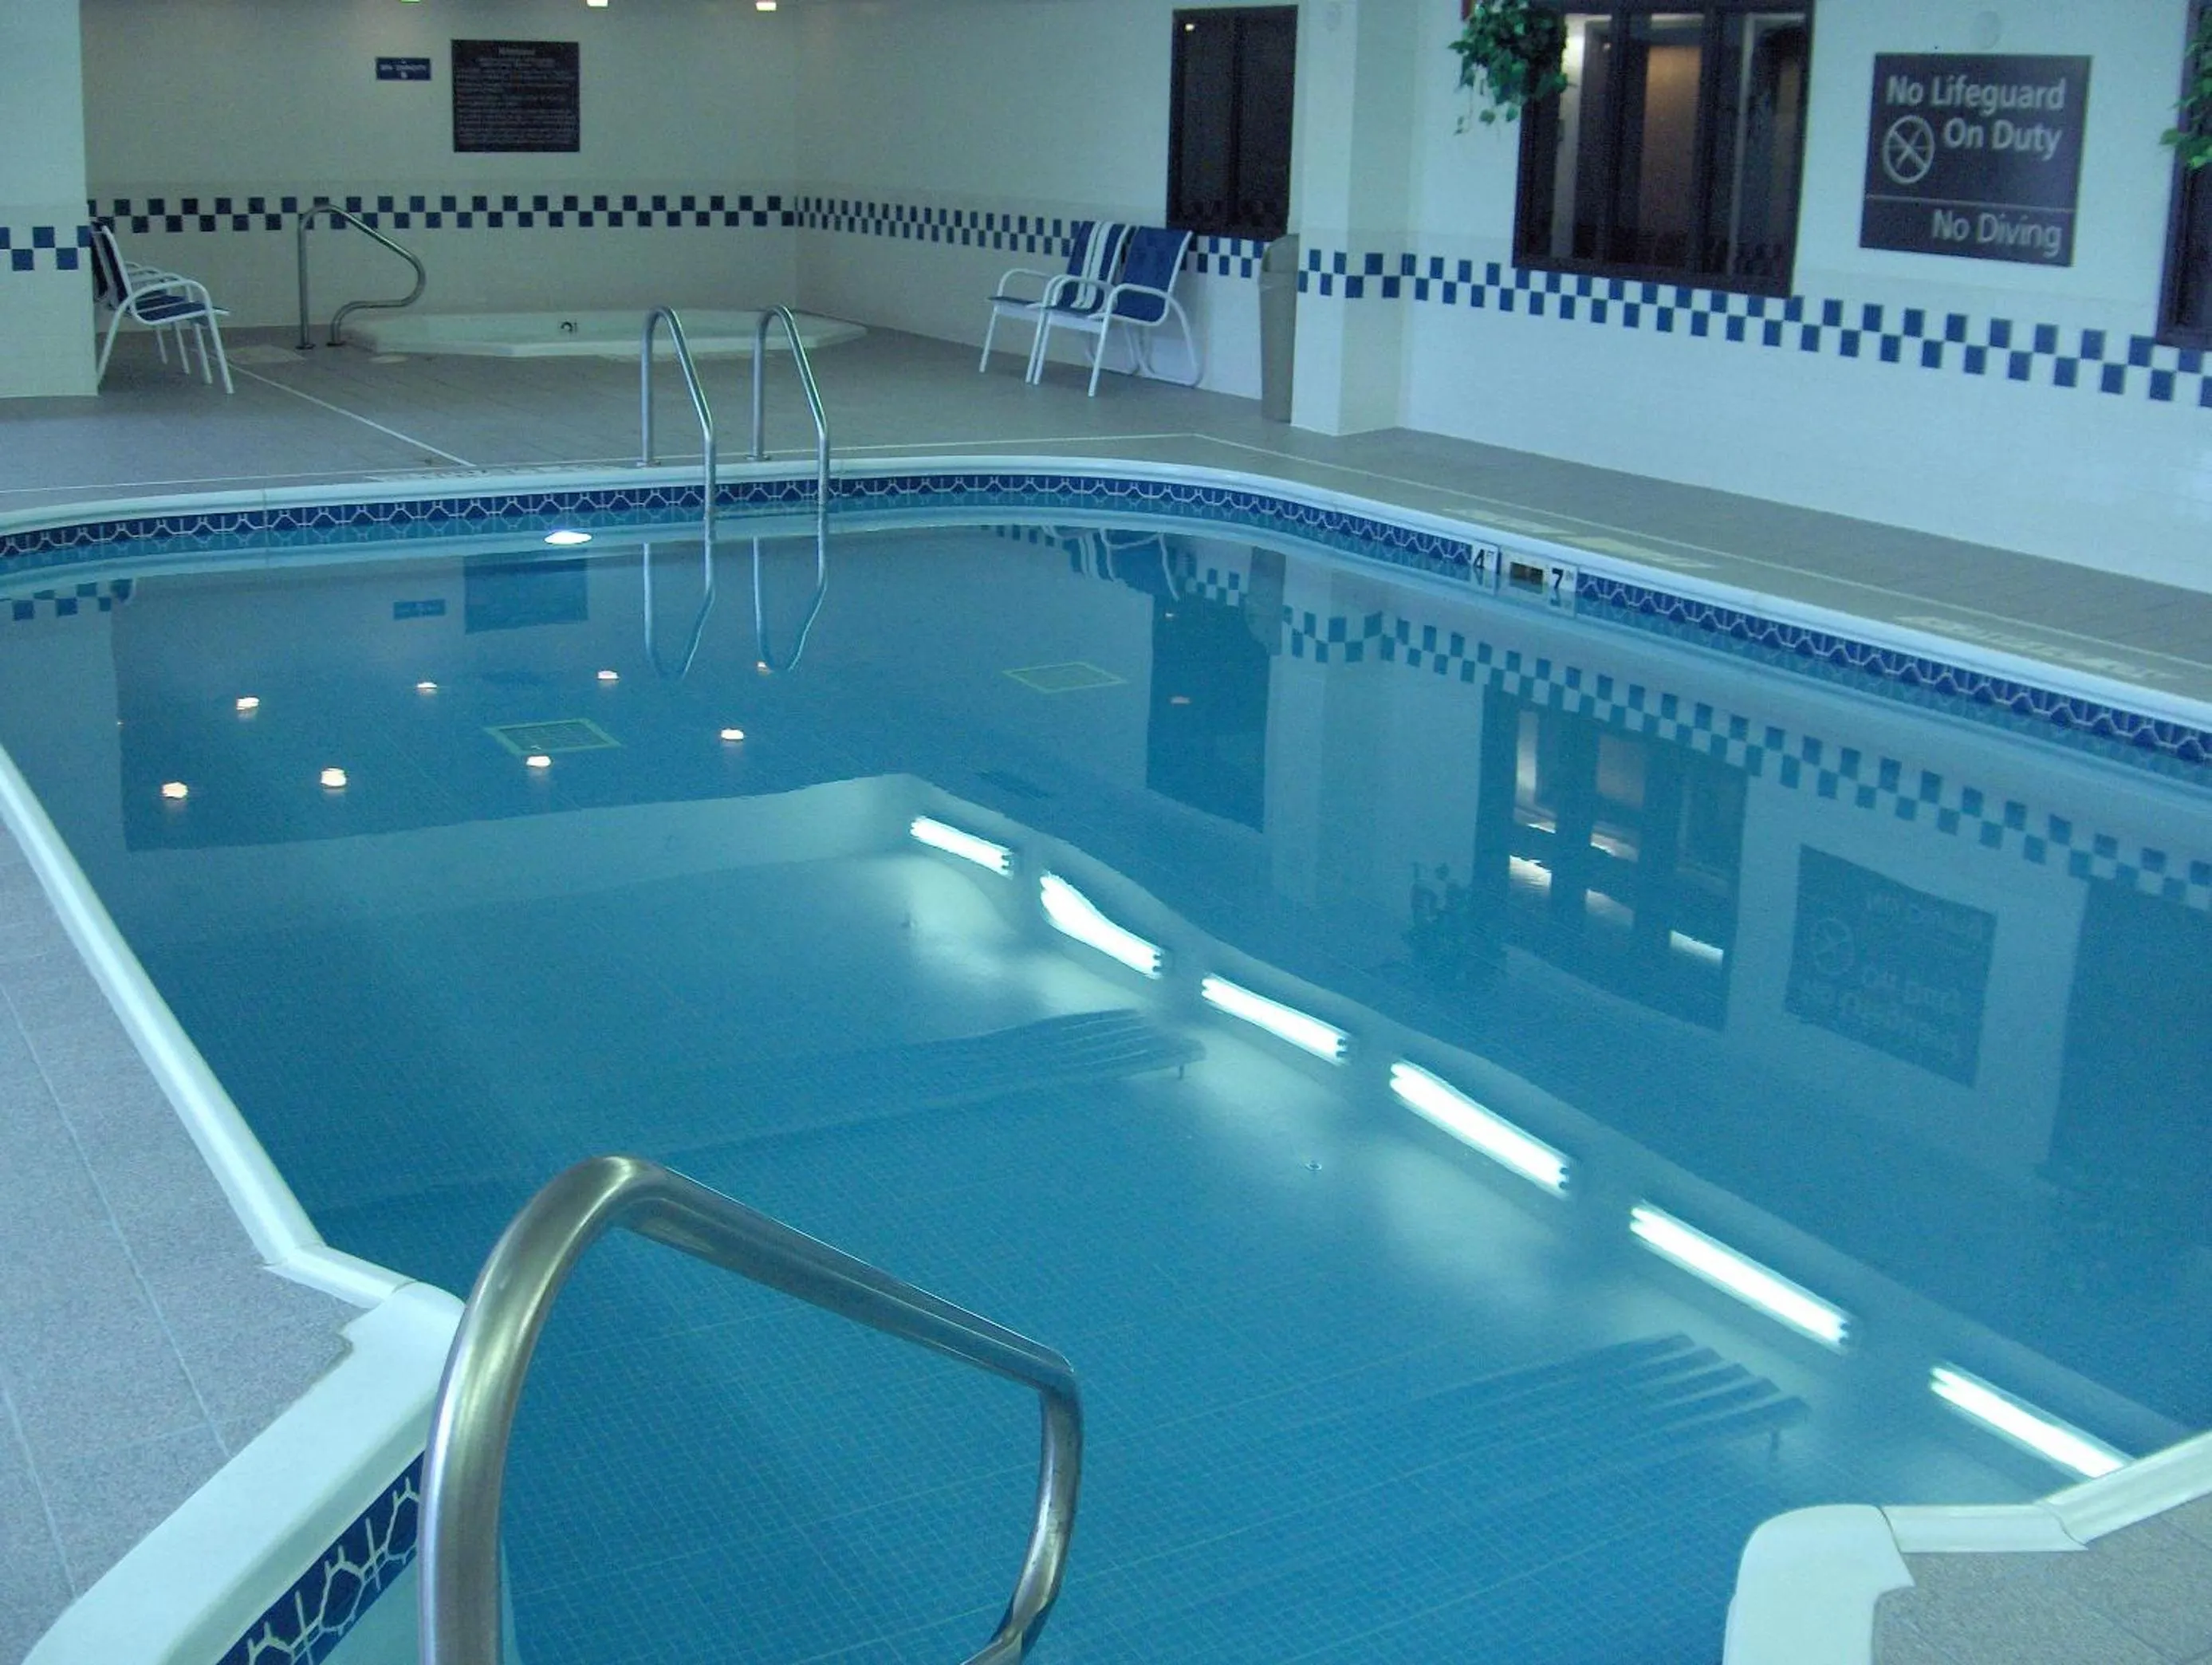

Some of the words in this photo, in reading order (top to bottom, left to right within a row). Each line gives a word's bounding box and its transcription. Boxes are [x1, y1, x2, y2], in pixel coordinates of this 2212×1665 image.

[1887, 75, 1923, 106] No
[1931, 75, 2066, 116] Lifeguard
[1945, 117, 1983, 148] On
[1992, 120, 2061, 161] Duty
[1932, 210, 1970, 241] No
[1978, 213, 2062, 258] Diving
[1474, 548, 1484, 569] 4
[1552, 568, 1564, 588] 7
